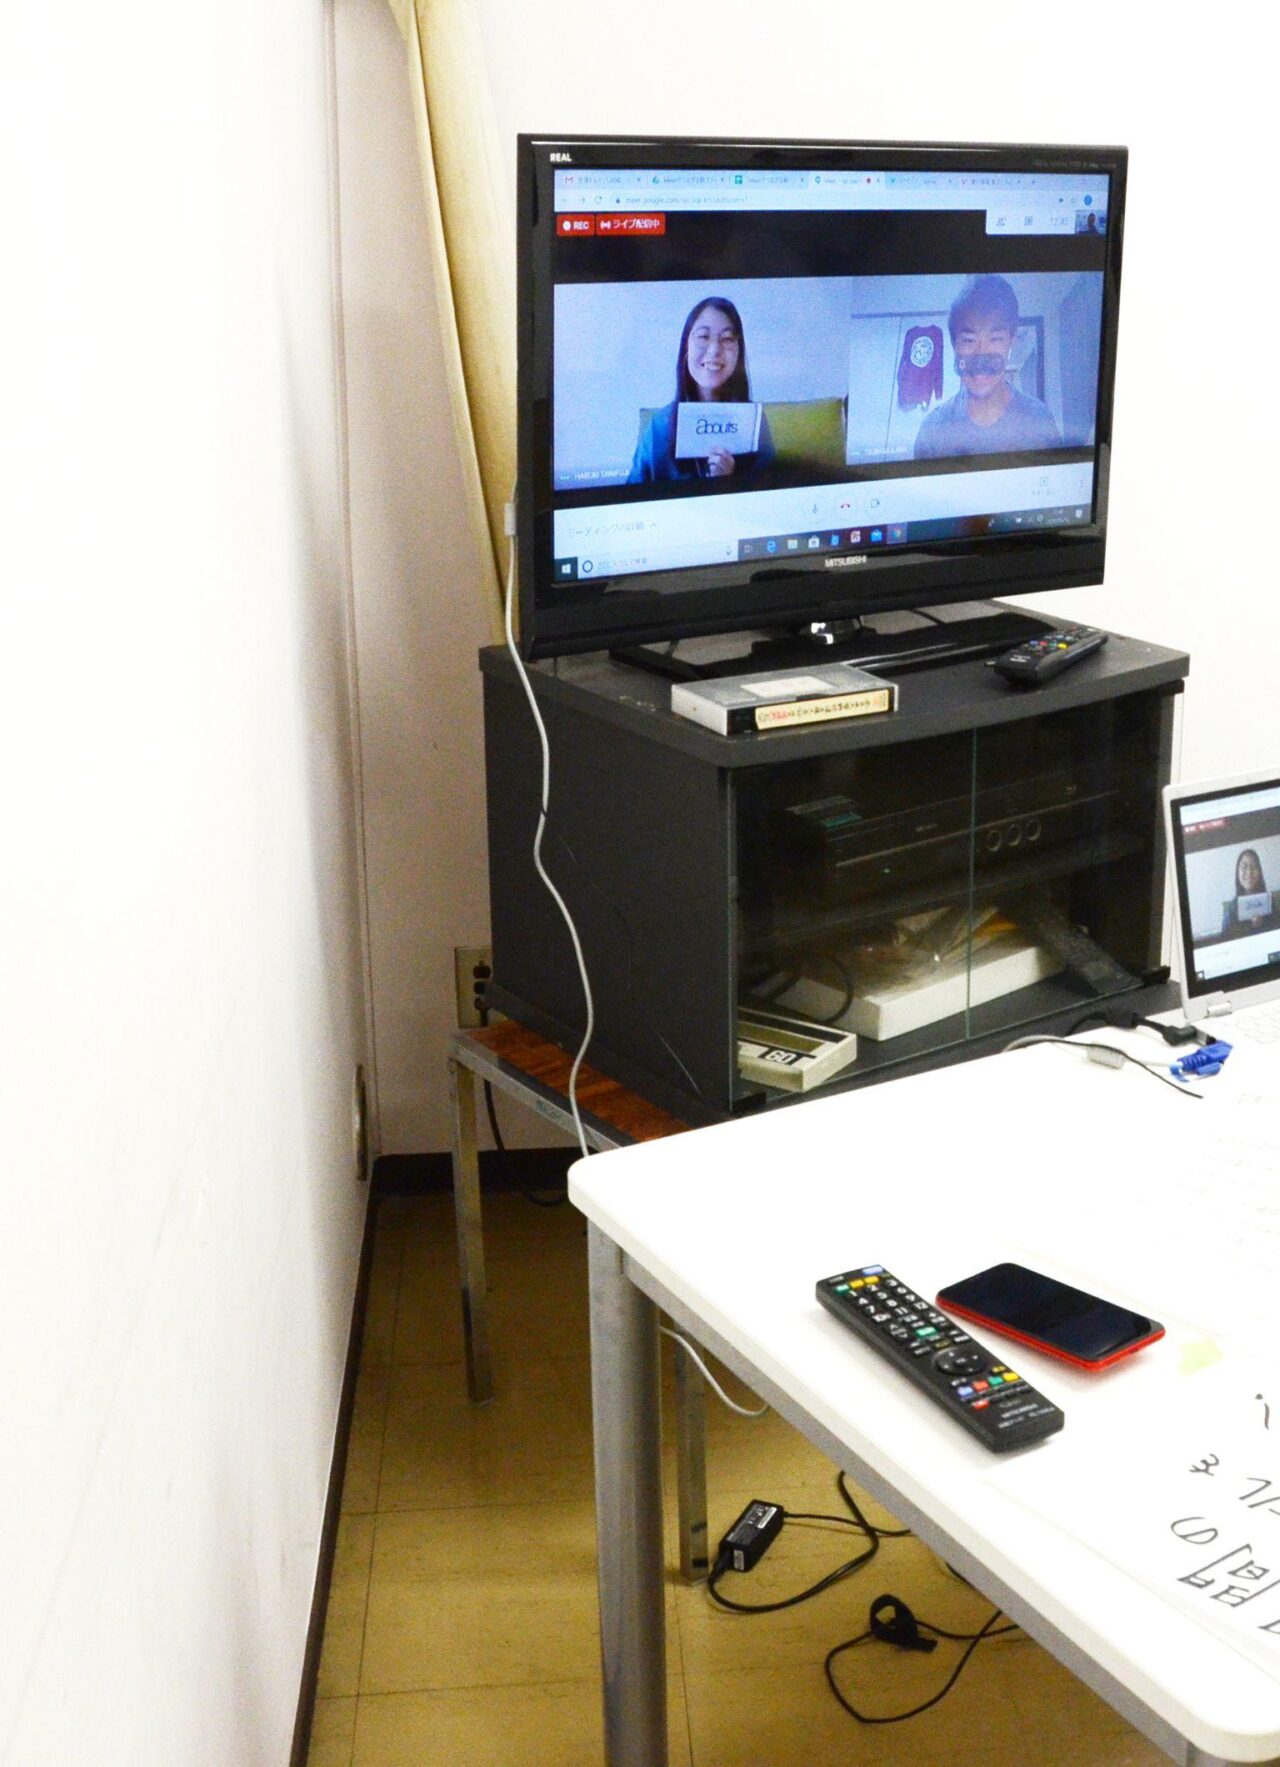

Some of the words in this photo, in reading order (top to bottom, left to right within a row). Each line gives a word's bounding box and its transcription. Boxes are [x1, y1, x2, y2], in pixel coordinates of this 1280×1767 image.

[550, 153, 572, 162] REAL
[573, 220, 589, 231] REC
[612, 218, 660, 230] ライブ配信中
[824, 555, 867, 568] MITSUBISHI
